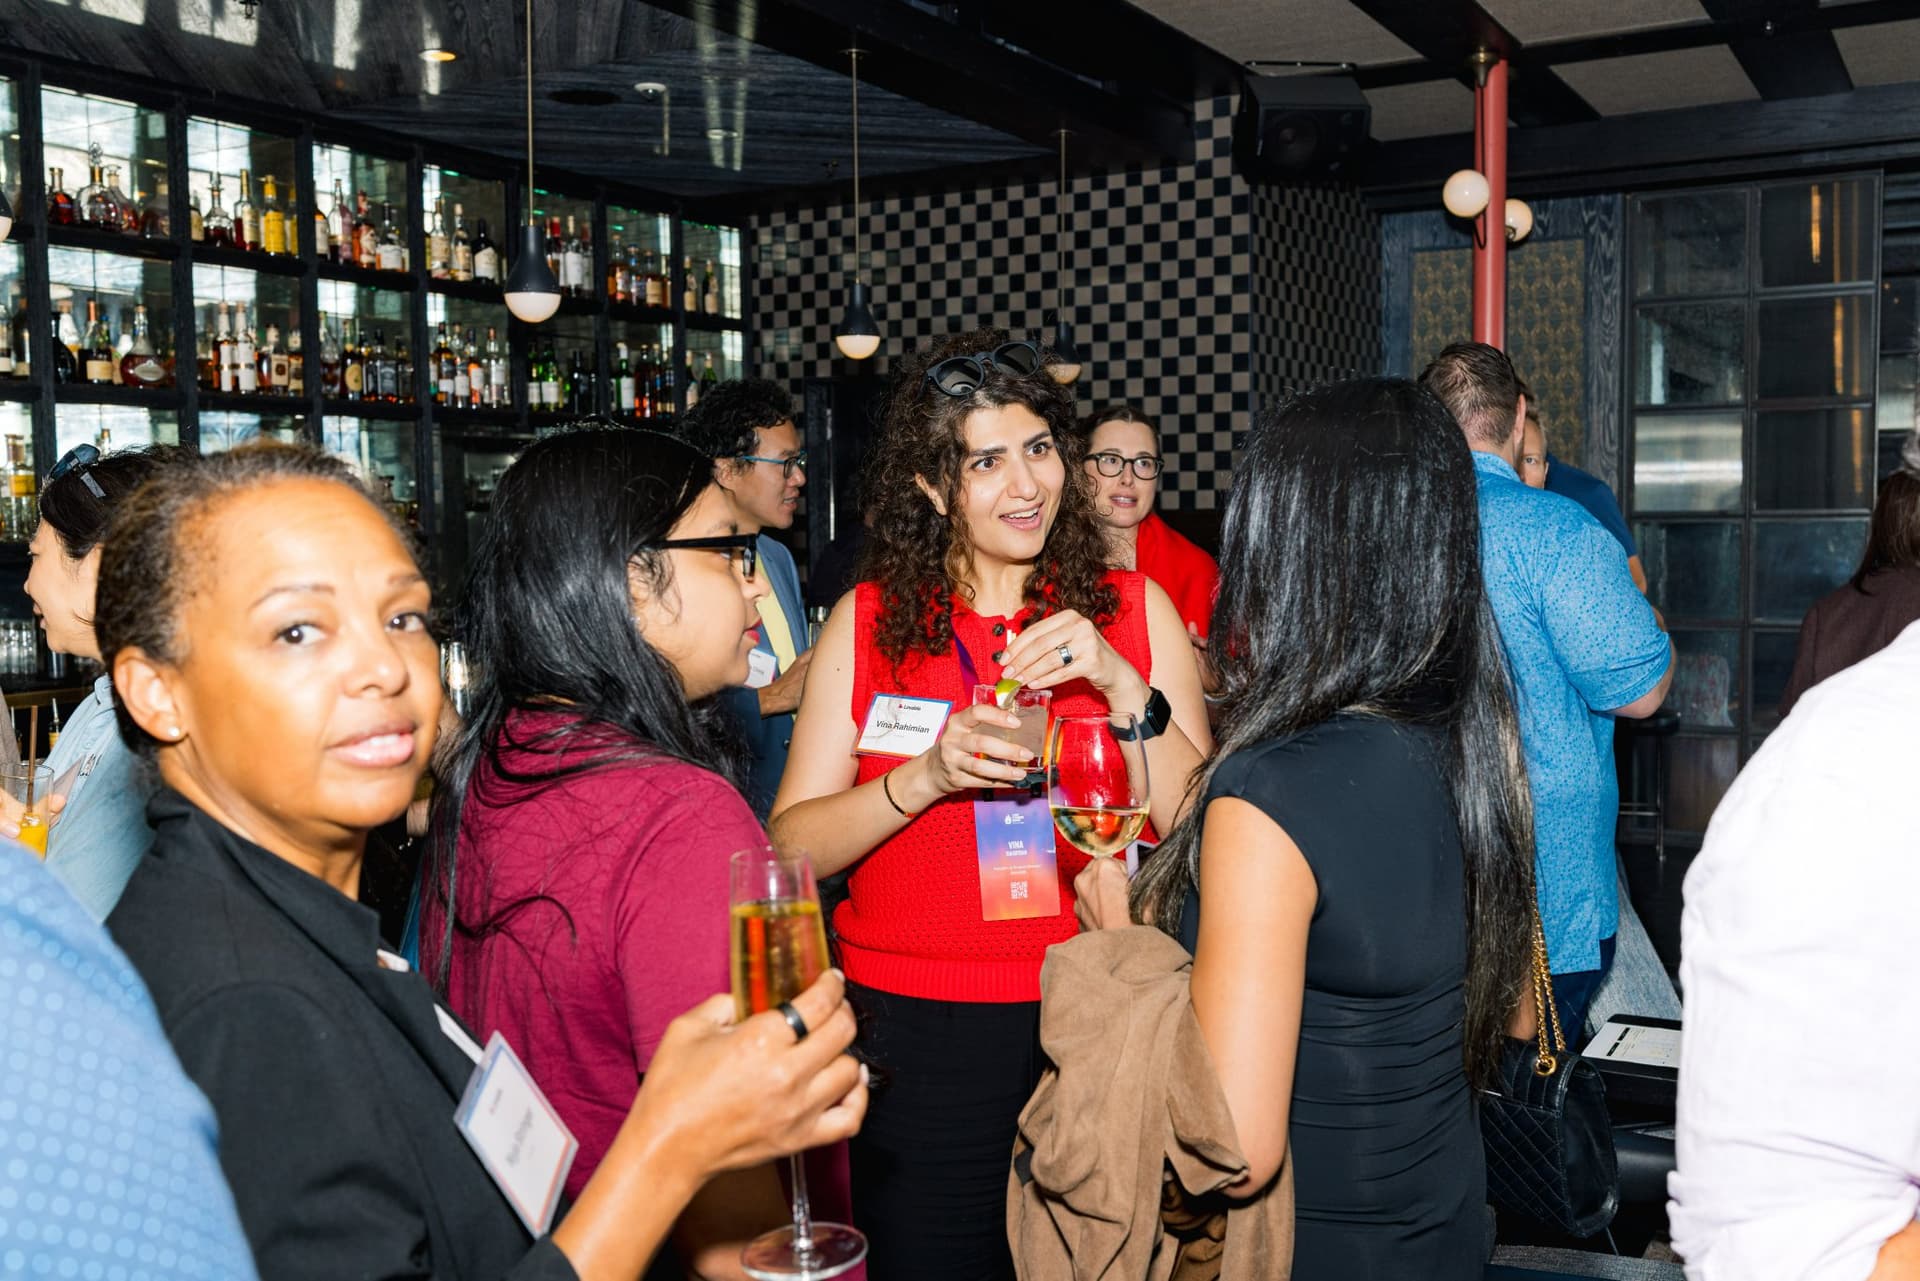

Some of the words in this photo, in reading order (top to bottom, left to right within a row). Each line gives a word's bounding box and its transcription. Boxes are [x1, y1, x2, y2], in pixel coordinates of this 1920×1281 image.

[876, 720, 893, 729] Vina
[893, 722, 930, 734] Rahimian
[1007, 840, 1024, 849] VINA
